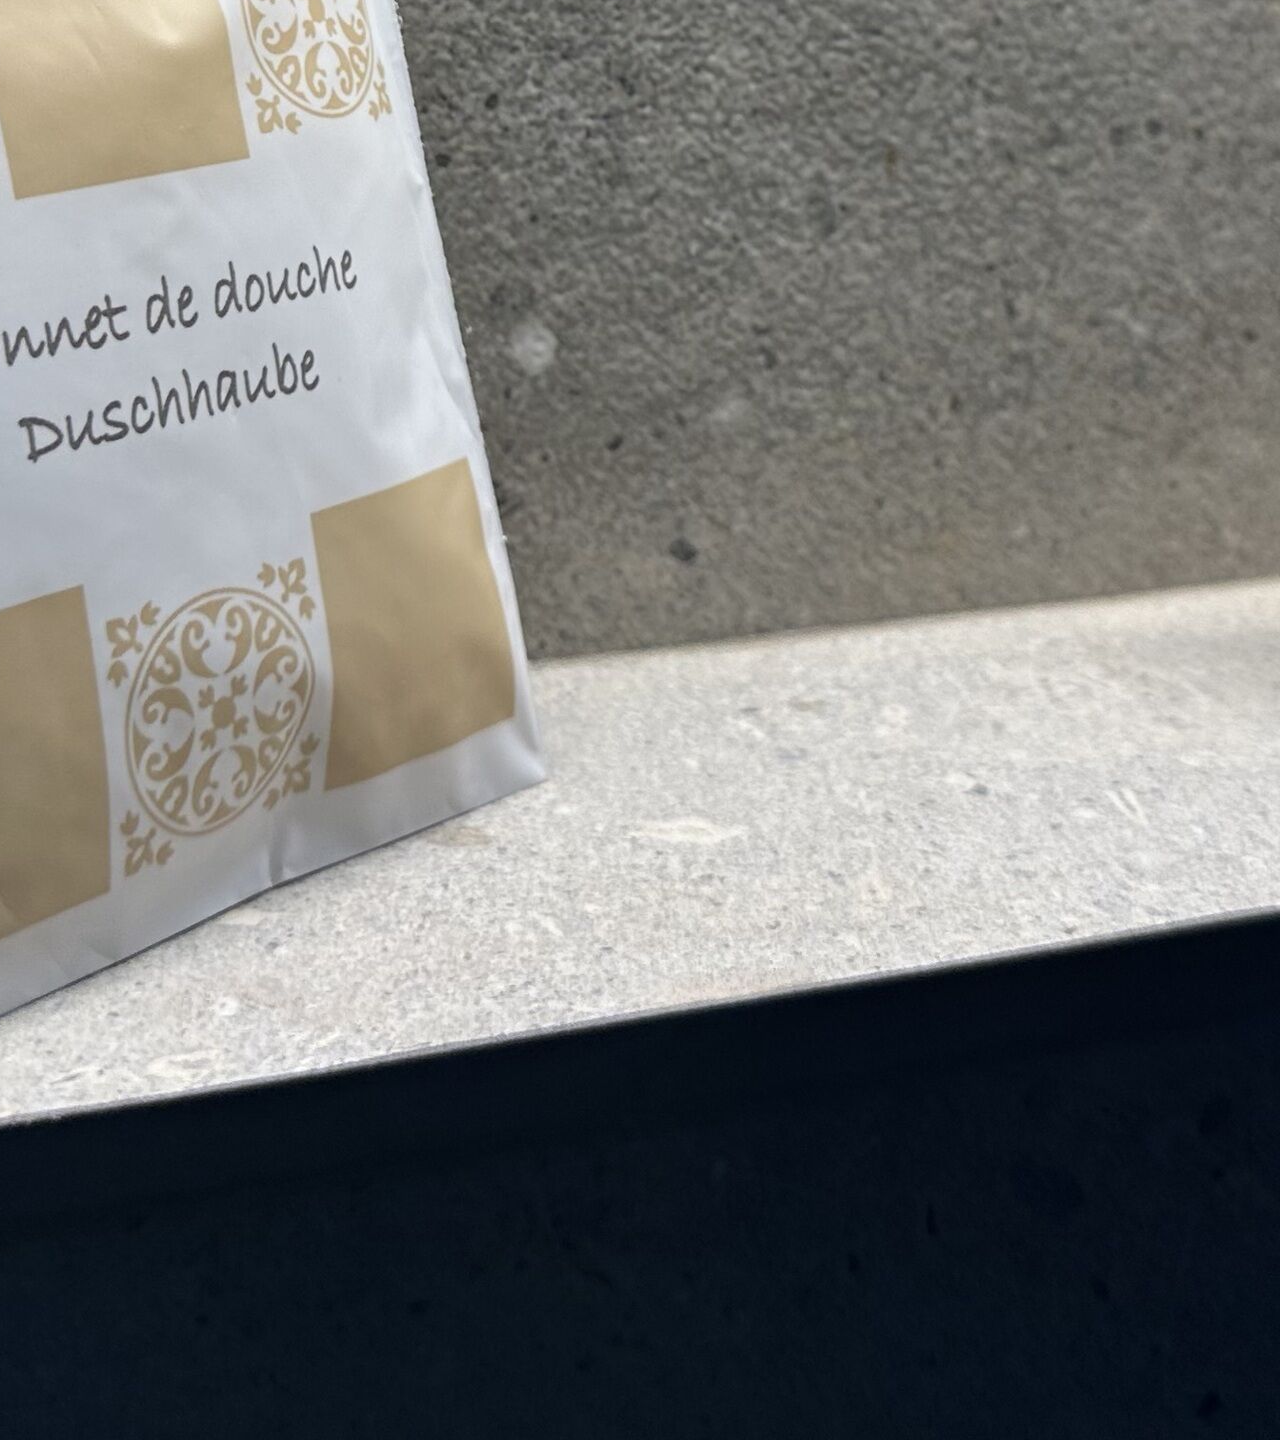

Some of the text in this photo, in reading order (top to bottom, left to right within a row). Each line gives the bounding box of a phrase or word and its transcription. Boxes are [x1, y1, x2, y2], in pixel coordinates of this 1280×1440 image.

[146, 274, 199, 334] de
[214, 245, 358, 318] douche
[18, 342, 321, 463] Duschhaube
